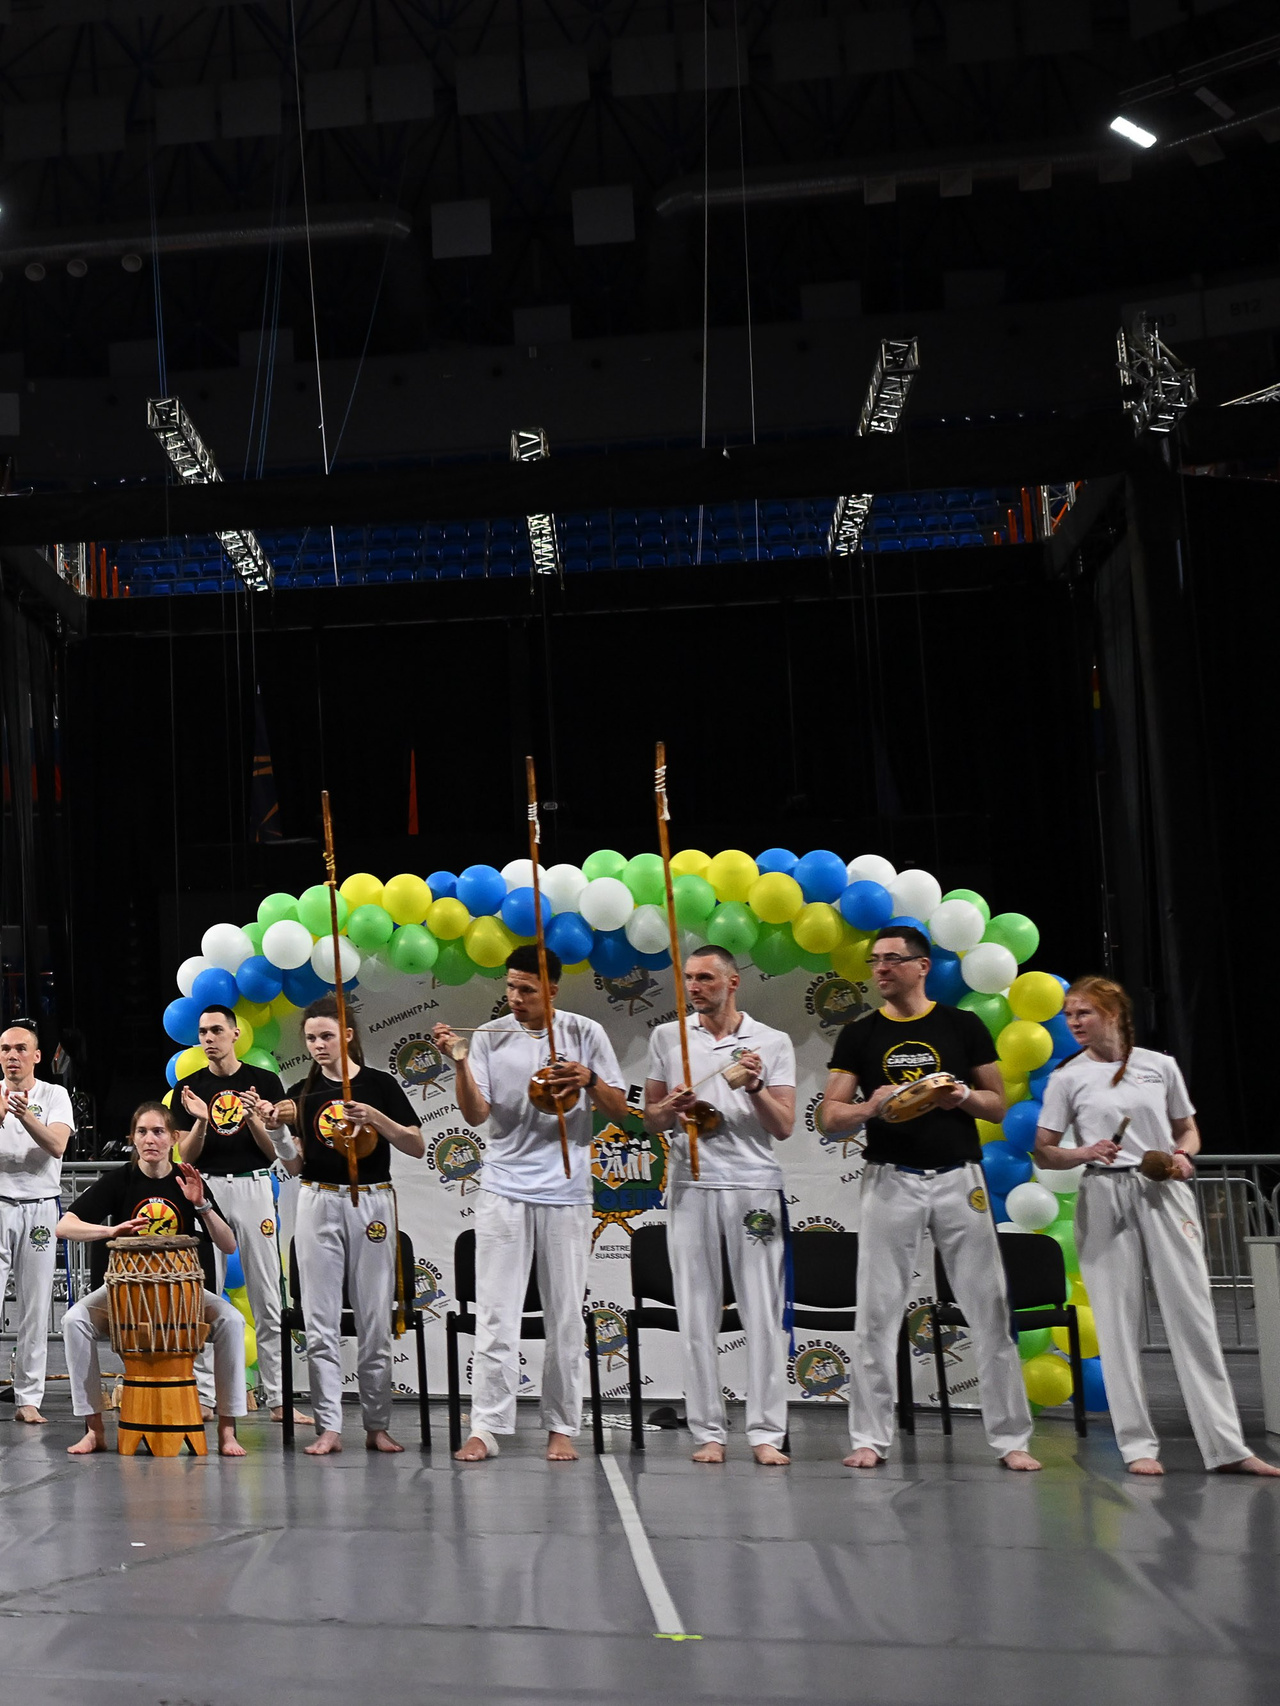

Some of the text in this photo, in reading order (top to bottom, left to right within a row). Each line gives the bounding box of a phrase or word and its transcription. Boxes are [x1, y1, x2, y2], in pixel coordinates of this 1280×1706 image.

[368, 999, 440, 1034] КАЛИНИНГРАД
[409, 1032, 422, 1041] DE
[446, 1127, 460, 1136] DE
[462, 1128, 487, 1151] OURO
[807, 1215, 821, 1224] DE
[418, 1258, 443, 1281] OURO
[592, 1300, 605, 1309] DE
[918, 1296, 933, 1305] DE
[807, 1339, 822, 1348] DE
[824, 1341, 851, 1365] OURO
